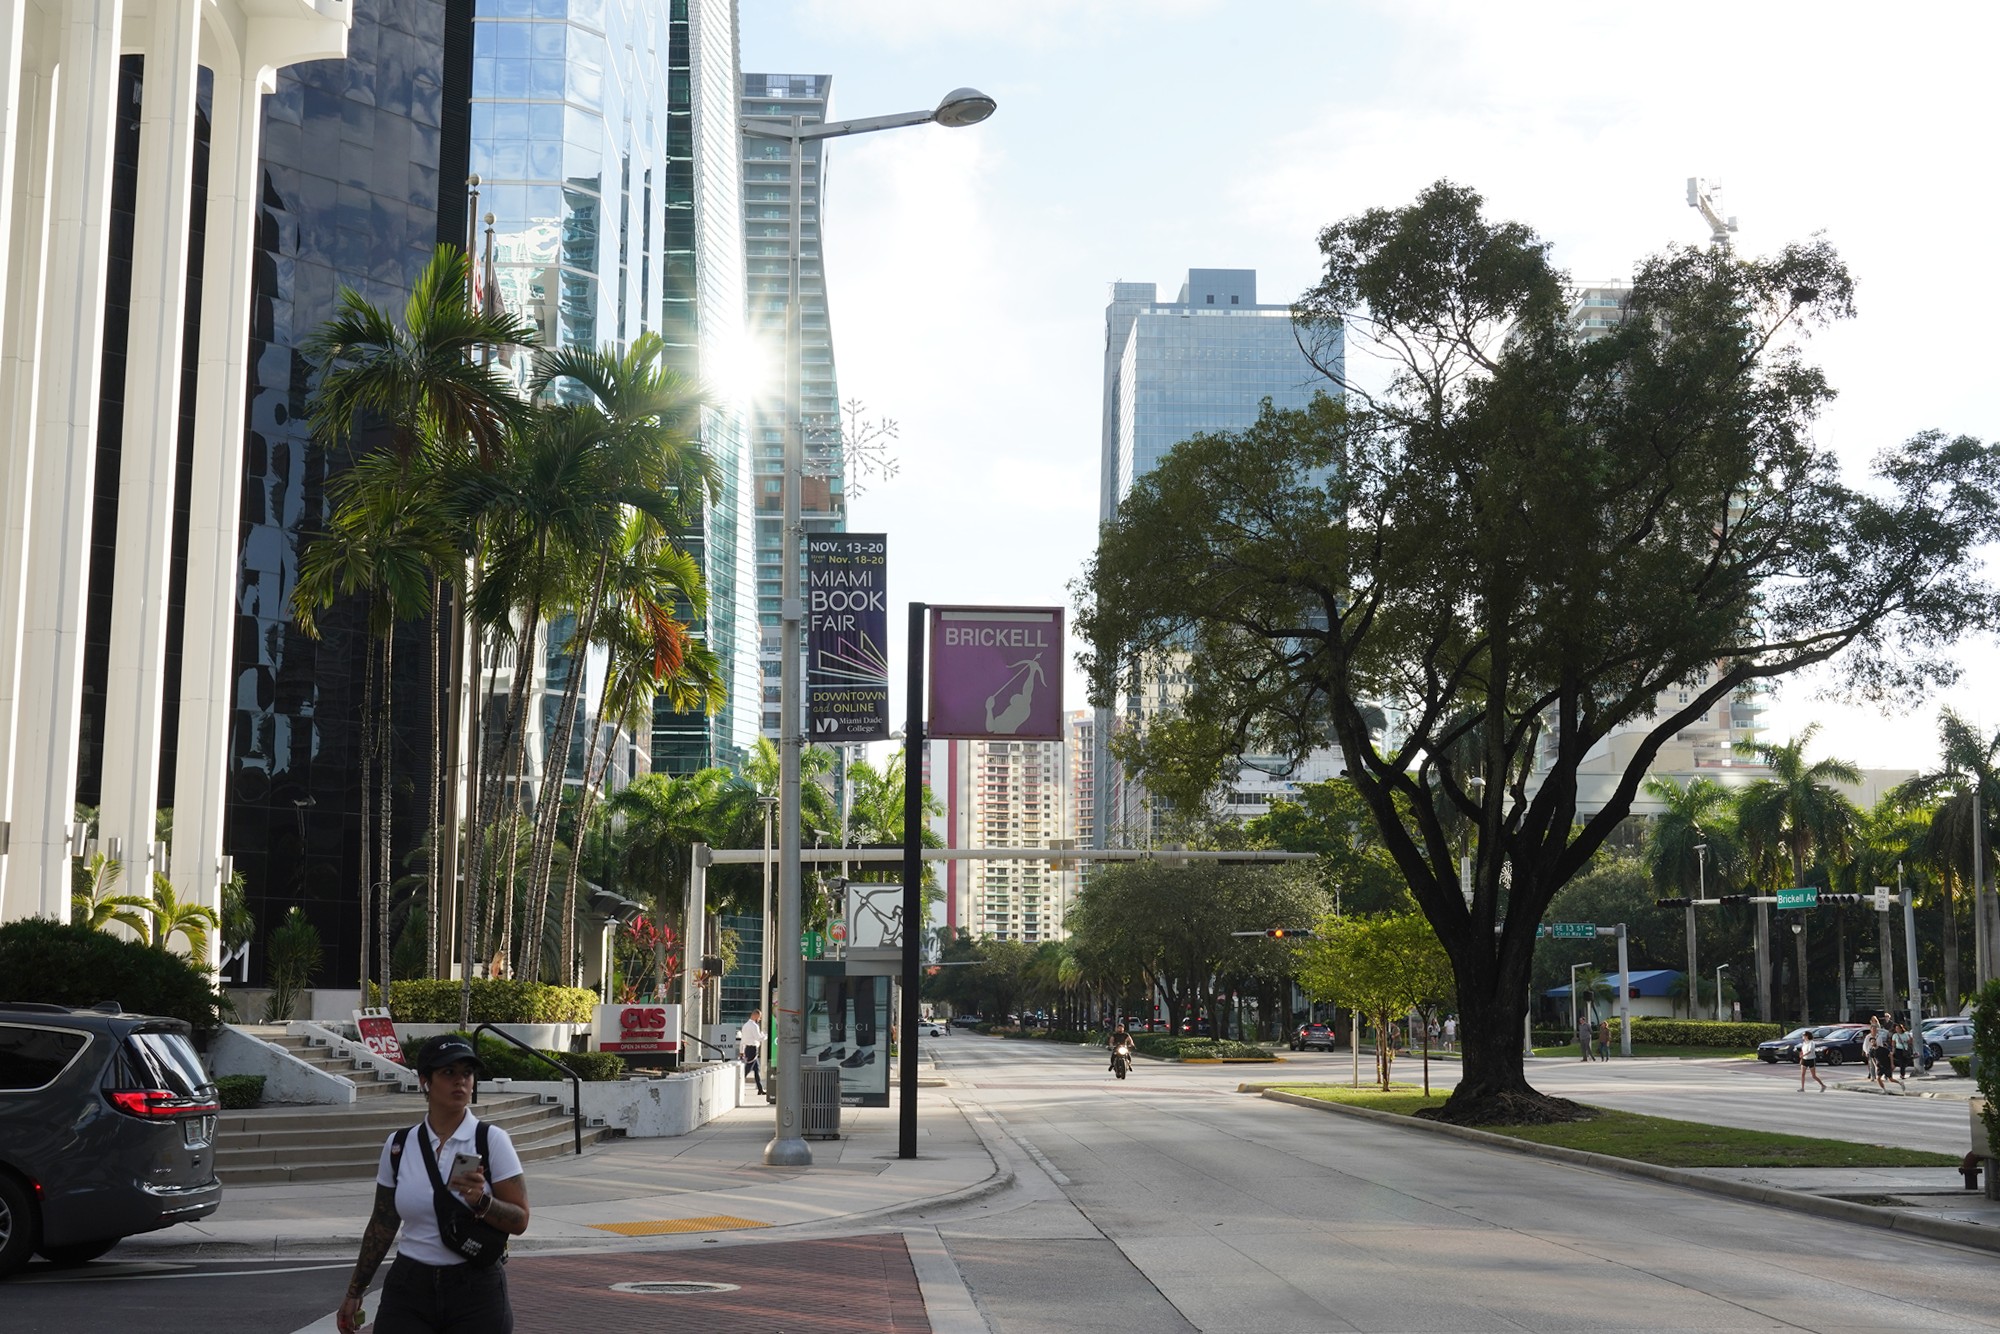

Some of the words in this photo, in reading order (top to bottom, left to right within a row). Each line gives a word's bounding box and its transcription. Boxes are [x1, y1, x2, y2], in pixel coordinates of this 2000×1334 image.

[810, 542, 841, 552] NOV.
[846, 542, 884, 554] 13-20
[828, 555, 851, 564] Nov.
[854, 555, 884, 565] 18-20
[811, 570, 872, 587] MIAMI
[811, 590, 885, 612] BOOK
[811, 615, 856, 632] FAIR
[945, 627, 1049, 648] BRICKELL
[813, 691, 886, 702] DOWNTOWN
[812, 703, 831, 713] and
[833, 703, 875, 713] ONLINE
[839, 717, 862, 725] Miami
[863, 716, 883, 724] Dade
[846, 725, 875, 734] College
[1778, 894, 1804, 904] Brickell
[1806, 893, 1817, 903] Av
[620, 1008, 667, 1029] CVS
[825, 1023, 869, 1031] GUCCI
[620, 1030, 665, 1040] pharmacy
[365, 1036, 399, 1053] CVS
